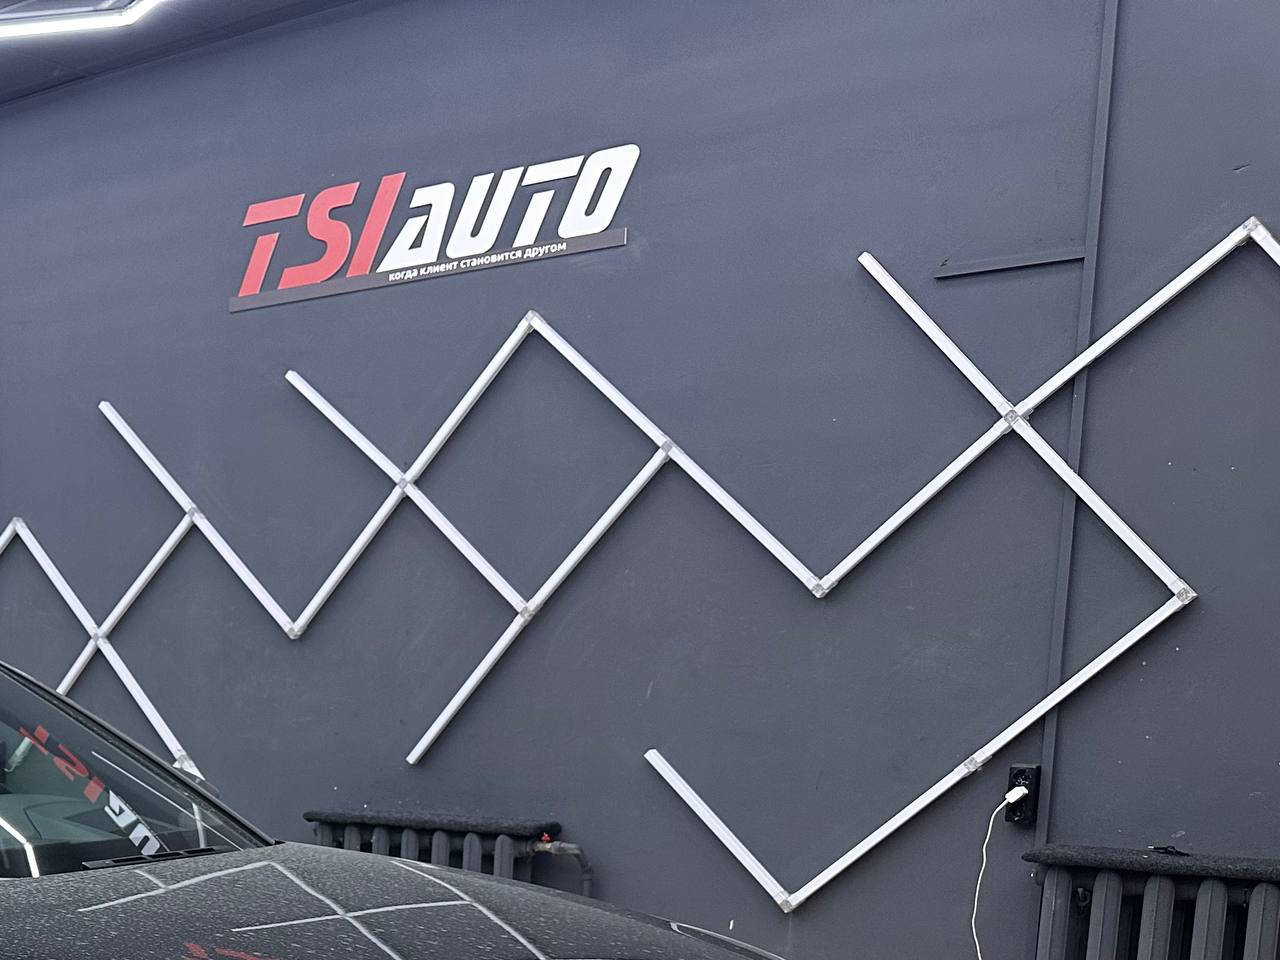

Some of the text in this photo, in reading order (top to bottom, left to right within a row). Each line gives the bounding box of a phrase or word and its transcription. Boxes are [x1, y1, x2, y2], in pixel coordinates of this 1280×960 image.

[388, 241, 567, 282] когда клиент становится другом
